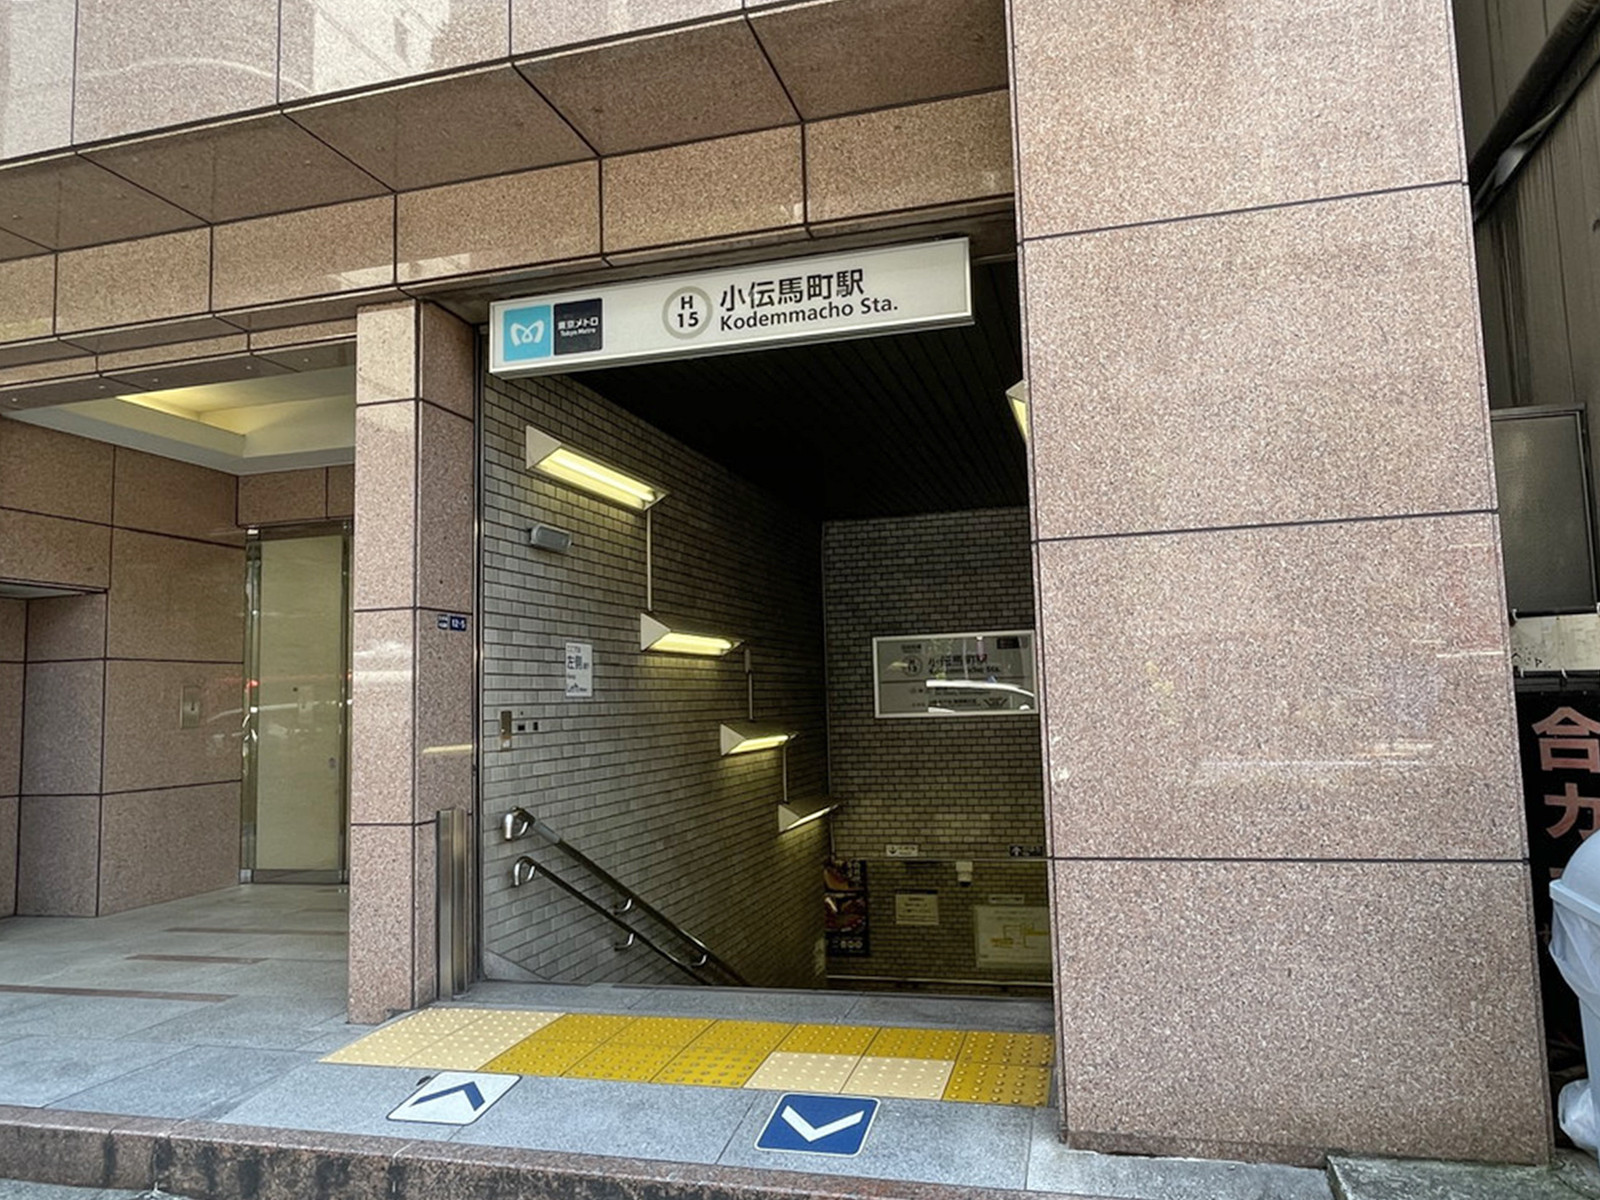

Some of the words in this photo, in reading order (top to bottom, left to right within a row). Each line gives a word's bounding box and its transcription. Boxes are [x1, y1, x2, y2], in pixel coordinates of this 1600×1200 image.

[680, 295, 694, 310] H
[720, 268, 865, 312] 小伝馬町駅
[557, 316, 599, 330] 東京メトロ
[677, 311, 699, 328] 15
[720, 302, 854, 331] Kodemmacho
[861, 297, 898, 315] Sta.
[1532, 706, 1600, 878] 合カ
